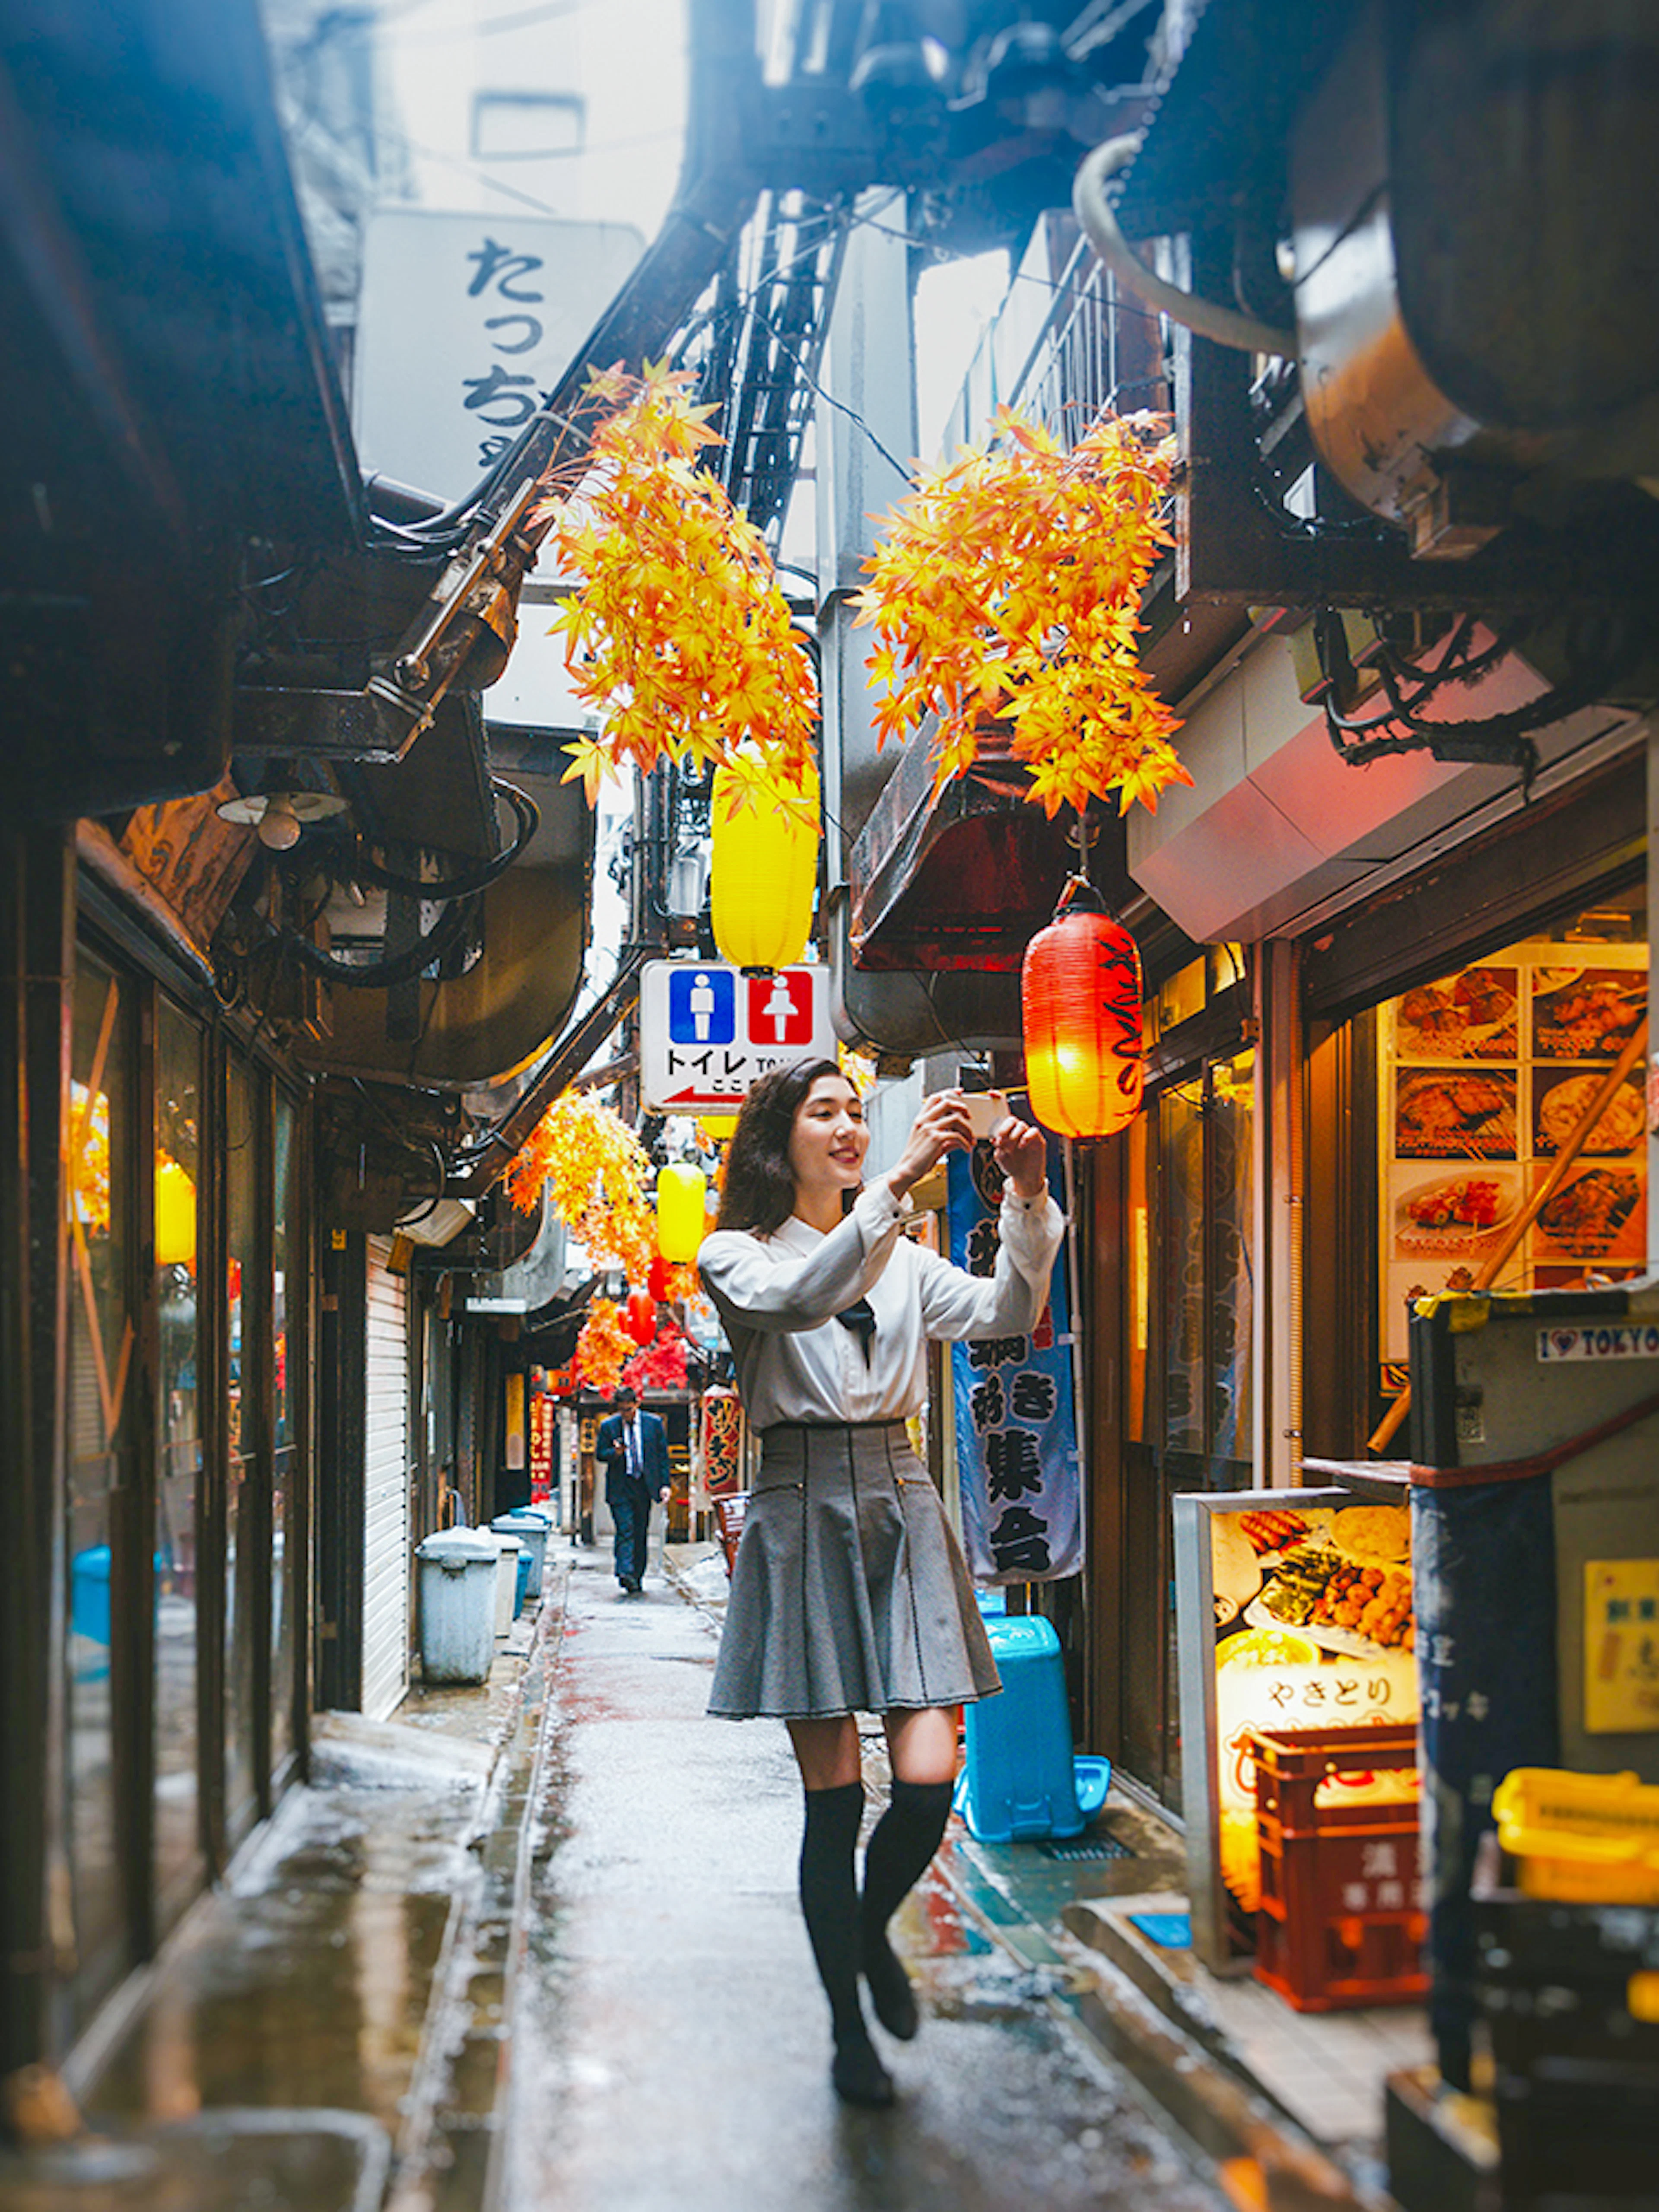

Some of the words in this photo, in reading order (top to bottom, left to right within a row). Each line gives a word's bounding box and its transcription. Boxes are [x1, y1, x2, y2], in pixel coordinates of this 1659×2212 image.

[668, 1049, 747, 1075] トイレ
[712, 1079, 757, 1092] ここ
[1581, 1326, 1659, 1356] TOKYO
[1268, 1677, 1391, 1709] やきとり
